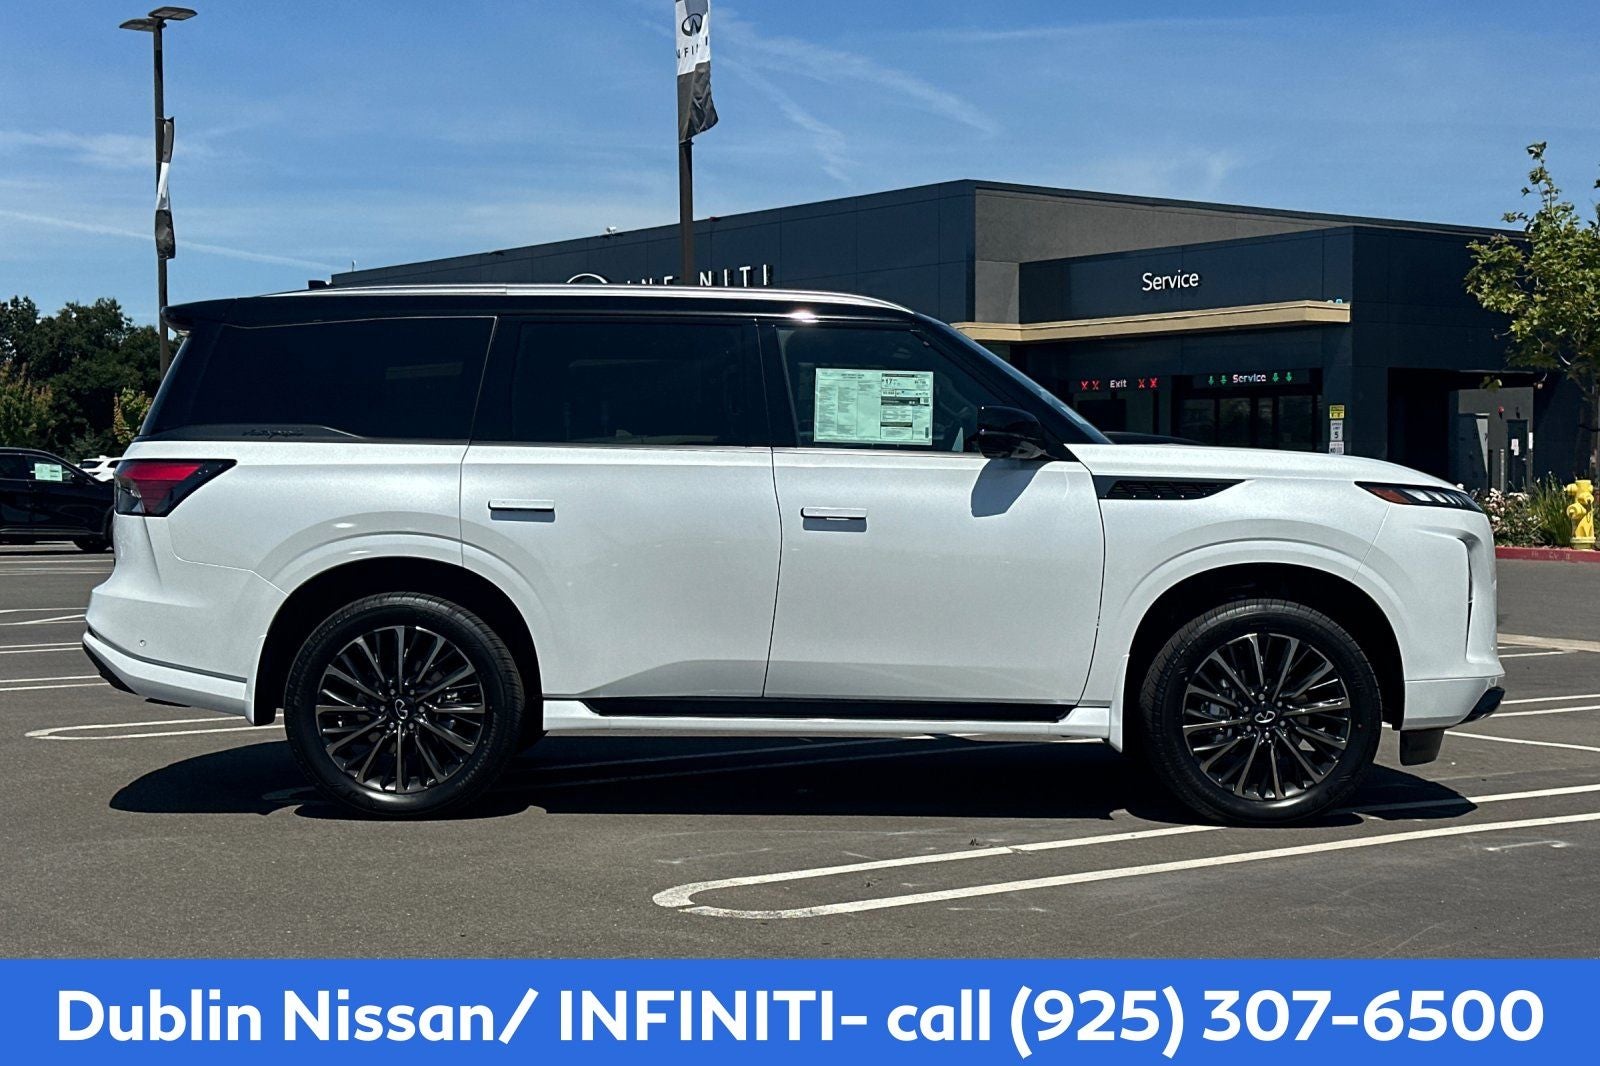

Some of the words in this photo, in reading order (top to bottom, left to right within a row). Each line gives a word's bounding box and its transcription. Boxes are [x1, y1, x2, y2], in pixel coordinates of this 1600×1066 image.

[1142, 269, 1199, 291] Service
[1232, 373, 1267, 383] Service
[1109, 379, 1127, 388] Exit
[1334, 431, 1339, 439] 5
